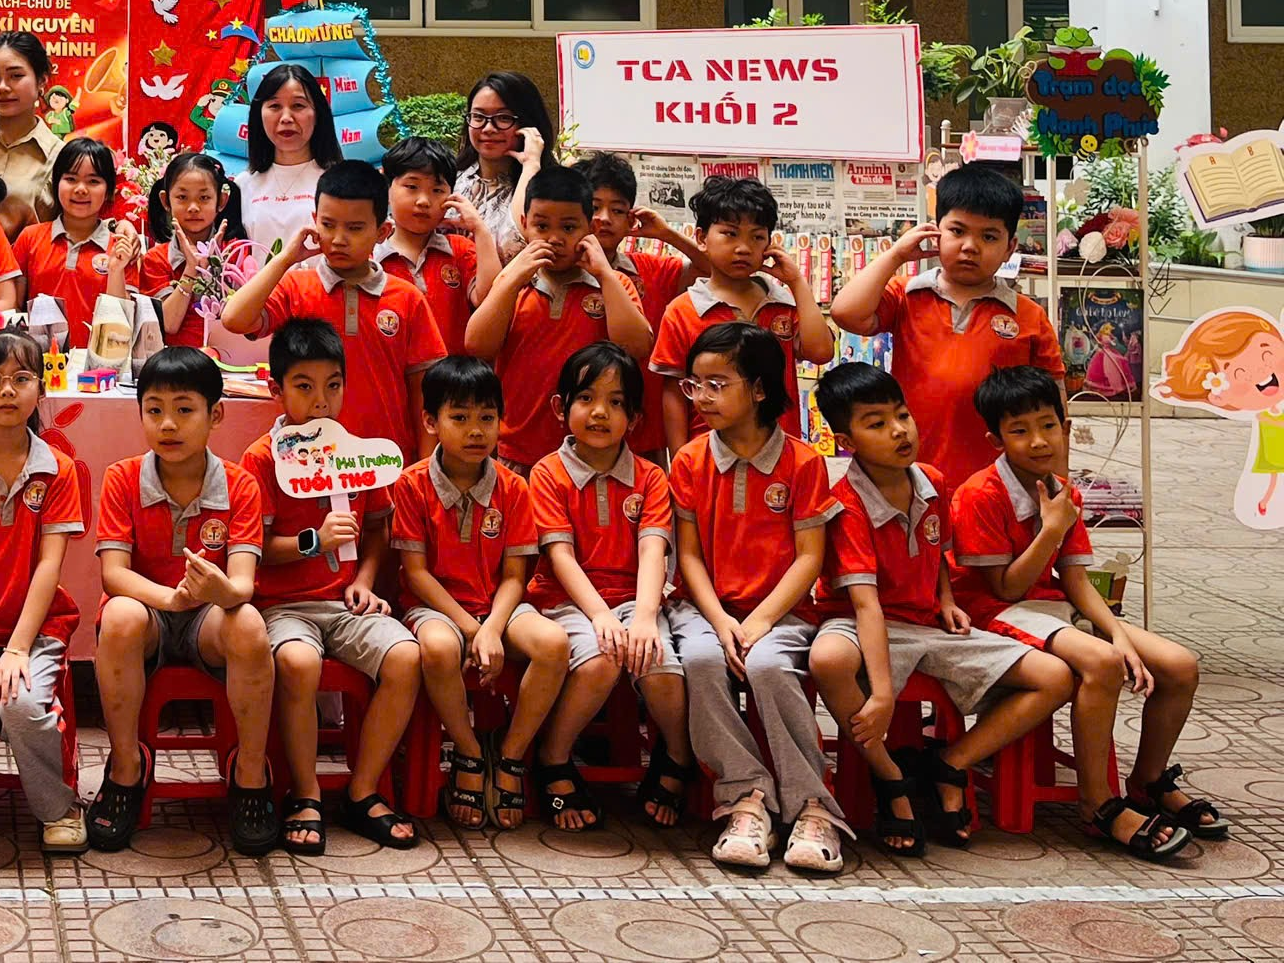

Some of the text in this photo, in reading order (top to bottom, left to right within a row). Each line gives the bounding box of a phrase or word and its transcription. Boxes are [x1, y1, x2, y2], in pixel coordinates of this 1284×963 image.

[18, 12, 95, 33] NGUYÊN
[46, 35, 96, 57] MÌNH
[616, 58, 839, 82] TCA NEWS
[655, 91, 798, 125] KHỐI 2
[341, 128, 362, 144] Nam
[772, 163, 809, 179] THANH
[864, 163, 891, 175] ninh
[357, 453, 402, 469] Trường
[289, 468, 377, 493] TUỔI THƠ
